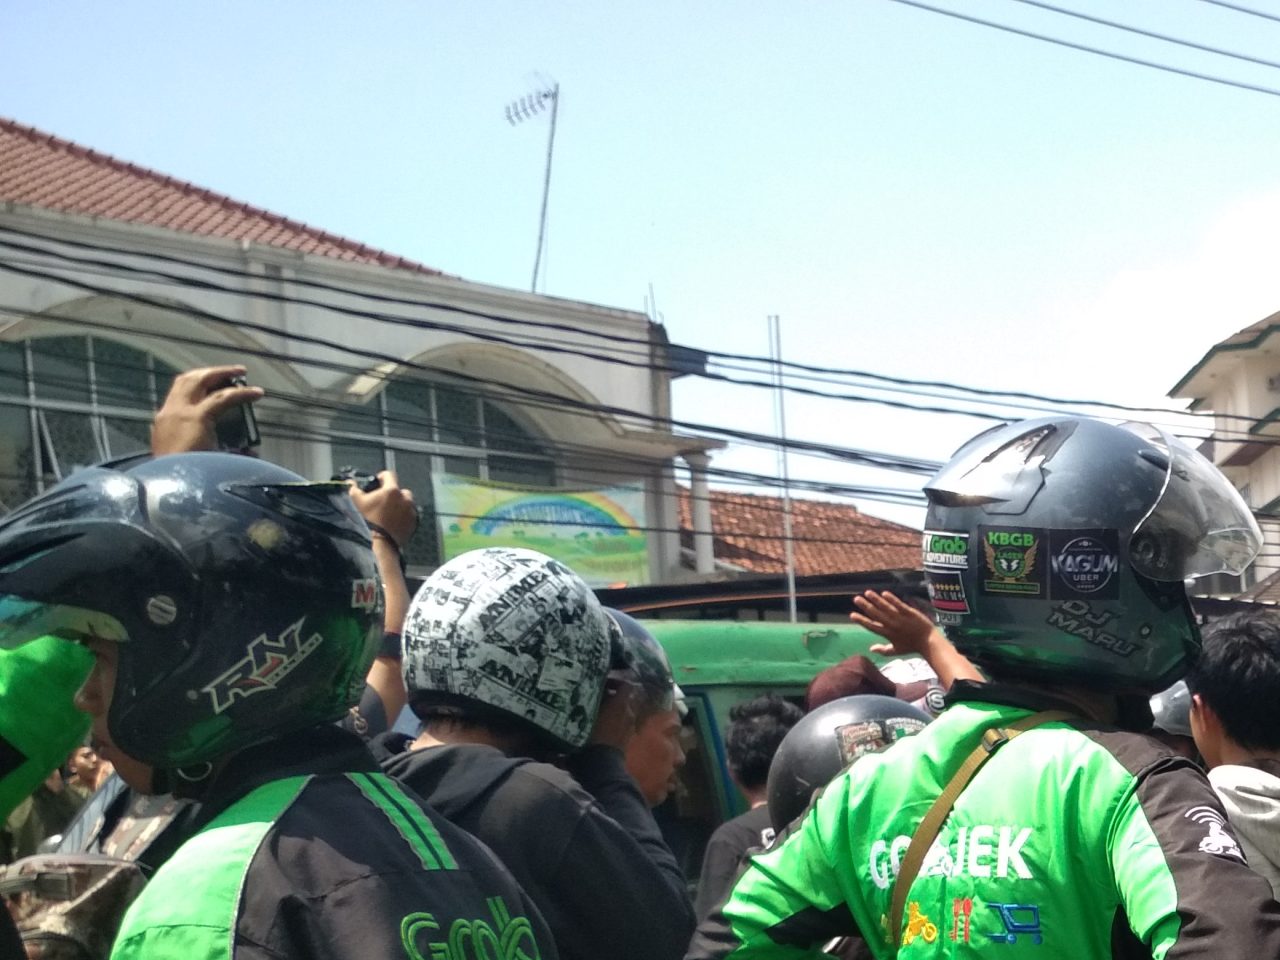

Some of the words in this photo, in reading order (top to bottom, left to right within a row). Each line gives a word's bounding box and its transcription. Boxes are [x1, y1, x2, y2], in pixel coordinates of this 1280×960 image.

[931, 535, 967, 554] Grab
[988, 531, 1034, 546] KBGB
[1051, 554, 1118, 573] KAGUM
[479, 569, 549, 631] ANIME
[1062, 600, 1111, 625] DJ
[1049, 611, 1136, 655] MARU
[479, 659, 567, 712] ANIME
